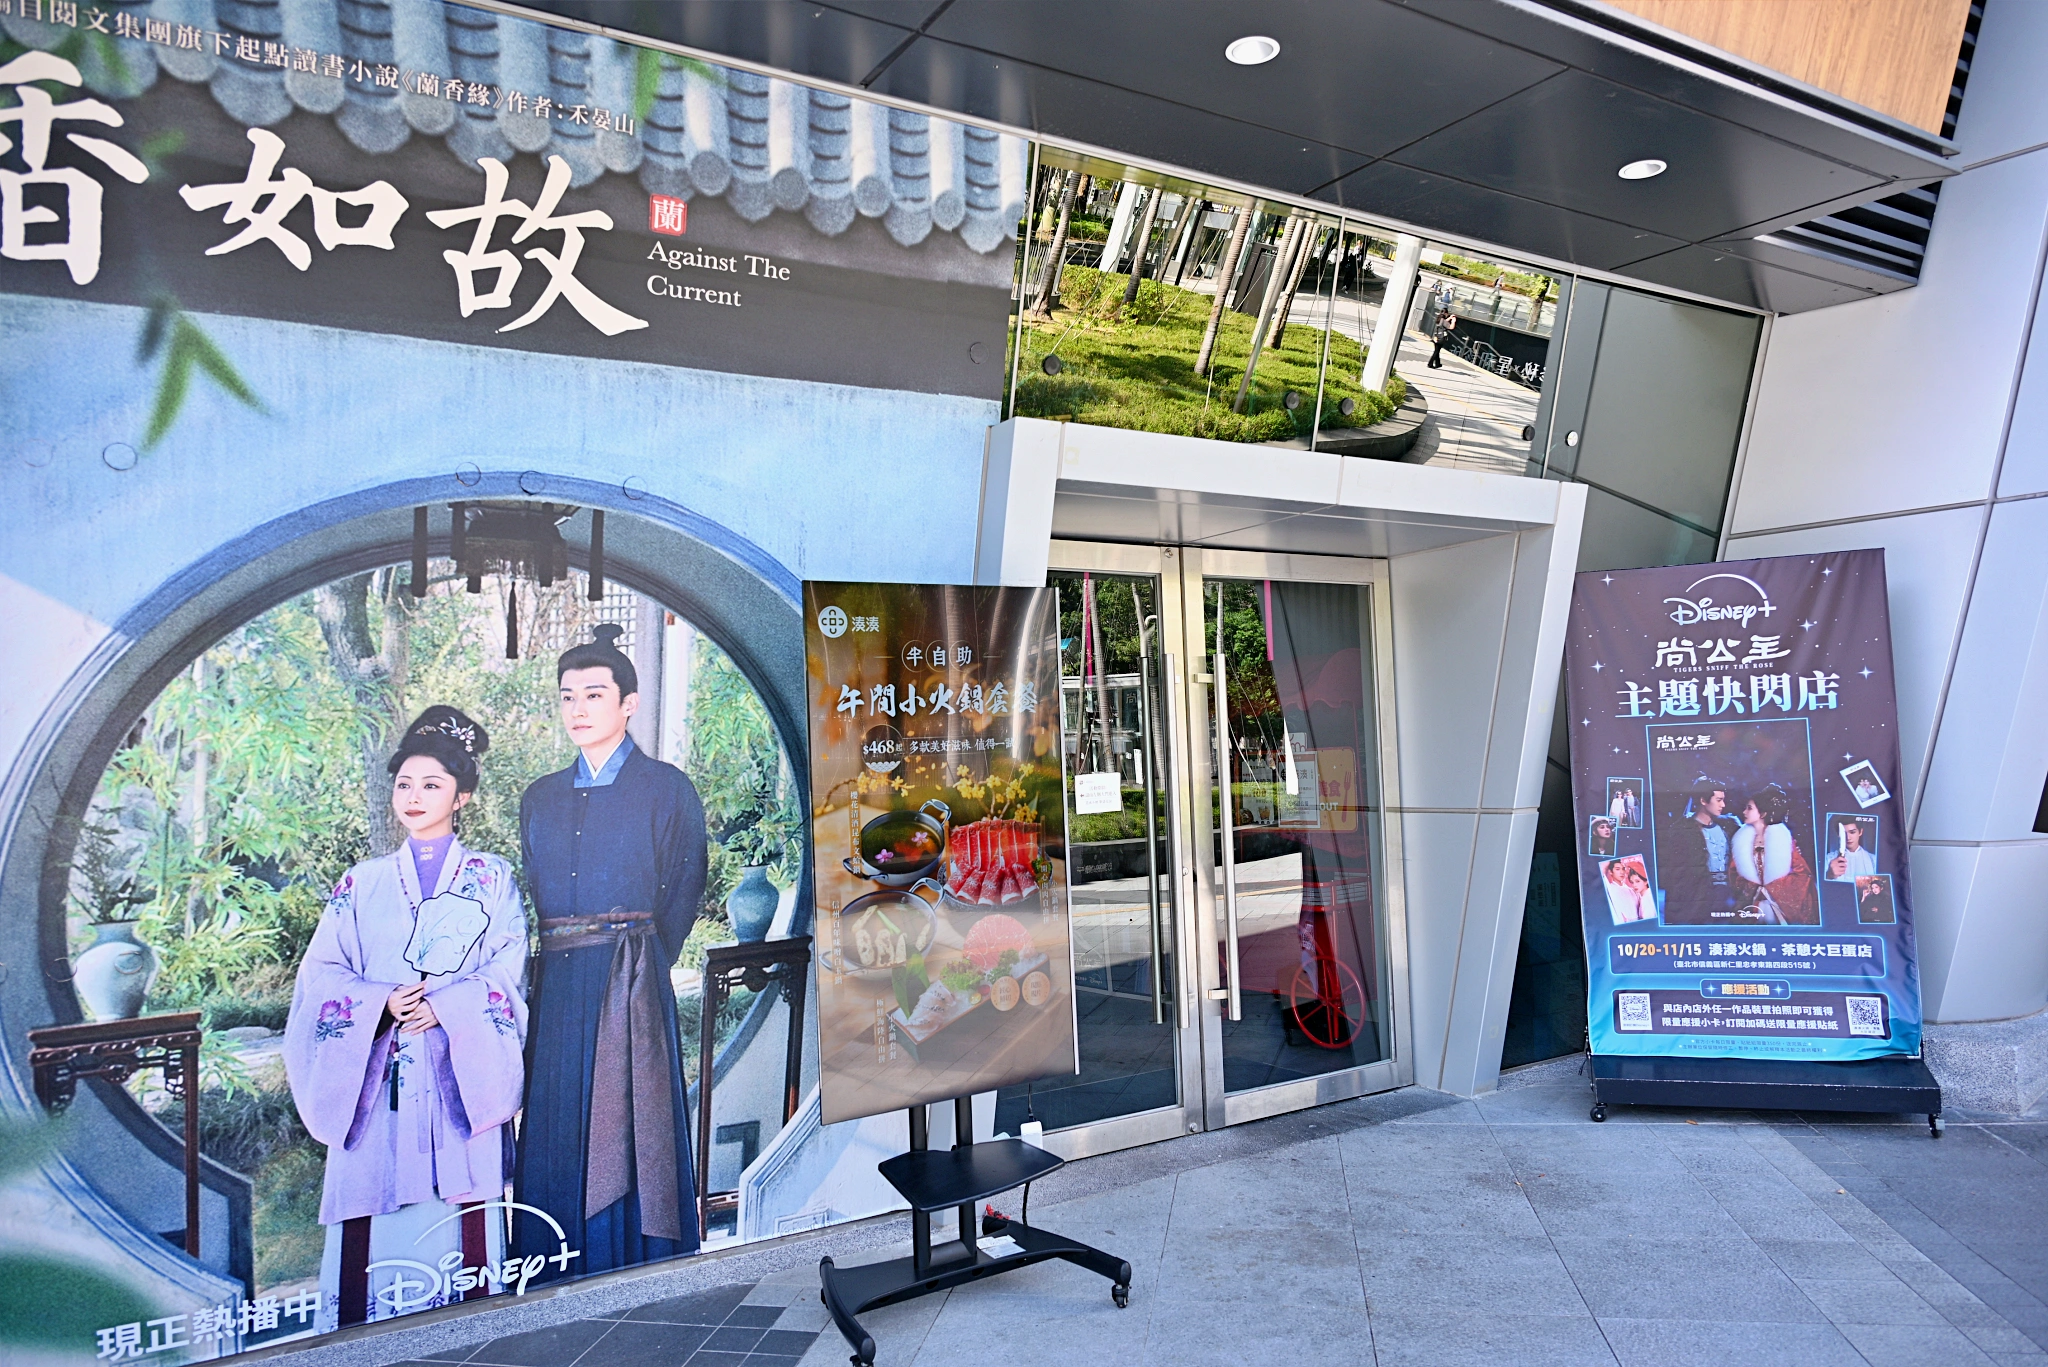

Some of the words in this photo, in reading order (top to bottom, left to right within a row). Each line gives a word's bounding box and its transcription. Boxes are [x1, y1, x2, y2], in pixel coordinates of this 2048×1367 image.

[0, 50, 649, 337] 香如故
[652, 199, 685, 232] 蘭
[647, 240, 738, 273] Against
[744, 254, 791, 281] The
[646, 274, 742, 307] Current
[851, 616, 880, 633] 湊湊
[1663, 597, 1777, 629] Disney+
[905, 645, 972, 667] 半自助
[1655, 634, 1791, 667] 尚公主
[836, 681, 1039, 718] 午間小火鍋套餐
[1614, 669, 1841, 718] 主題快閃店
[1656, 734, 1716, 749] 尚公主
[1617, 943, 1702, 958] 10/20-11/15
[1721, 983, 1770, 996] 應援活動
[96, 1288, 322, 1362] 現正熱播中
[365, 1241, 581, 1311] Disney+
